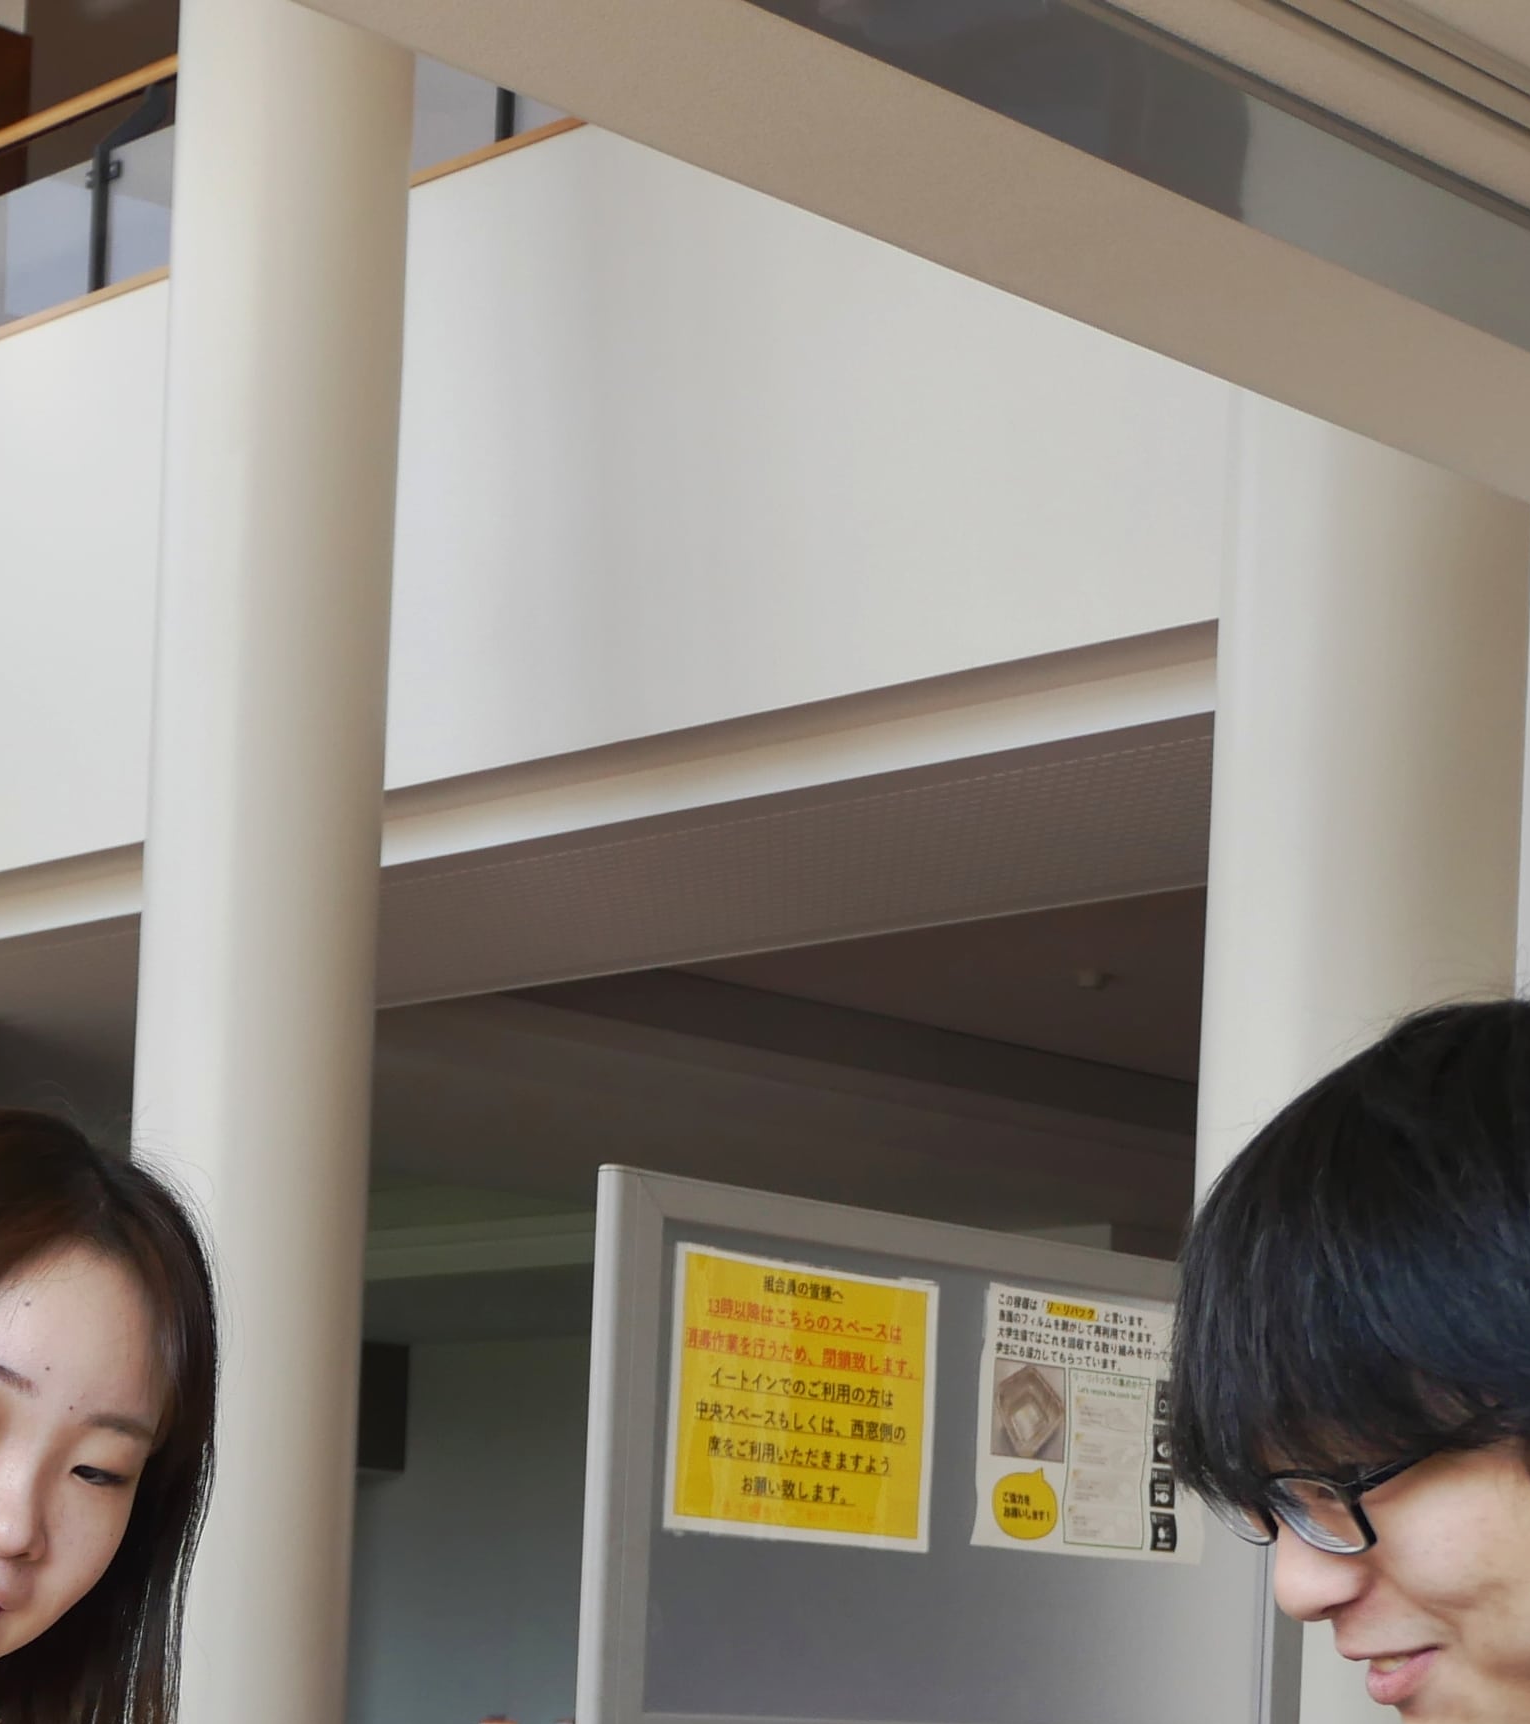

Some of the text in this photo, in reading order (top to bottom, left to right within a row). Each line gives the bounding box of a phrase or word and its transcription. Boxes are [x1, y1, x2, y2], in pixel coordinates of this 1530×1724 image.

[711, 1367, 894, 1408] イートインでのご利用の方は
